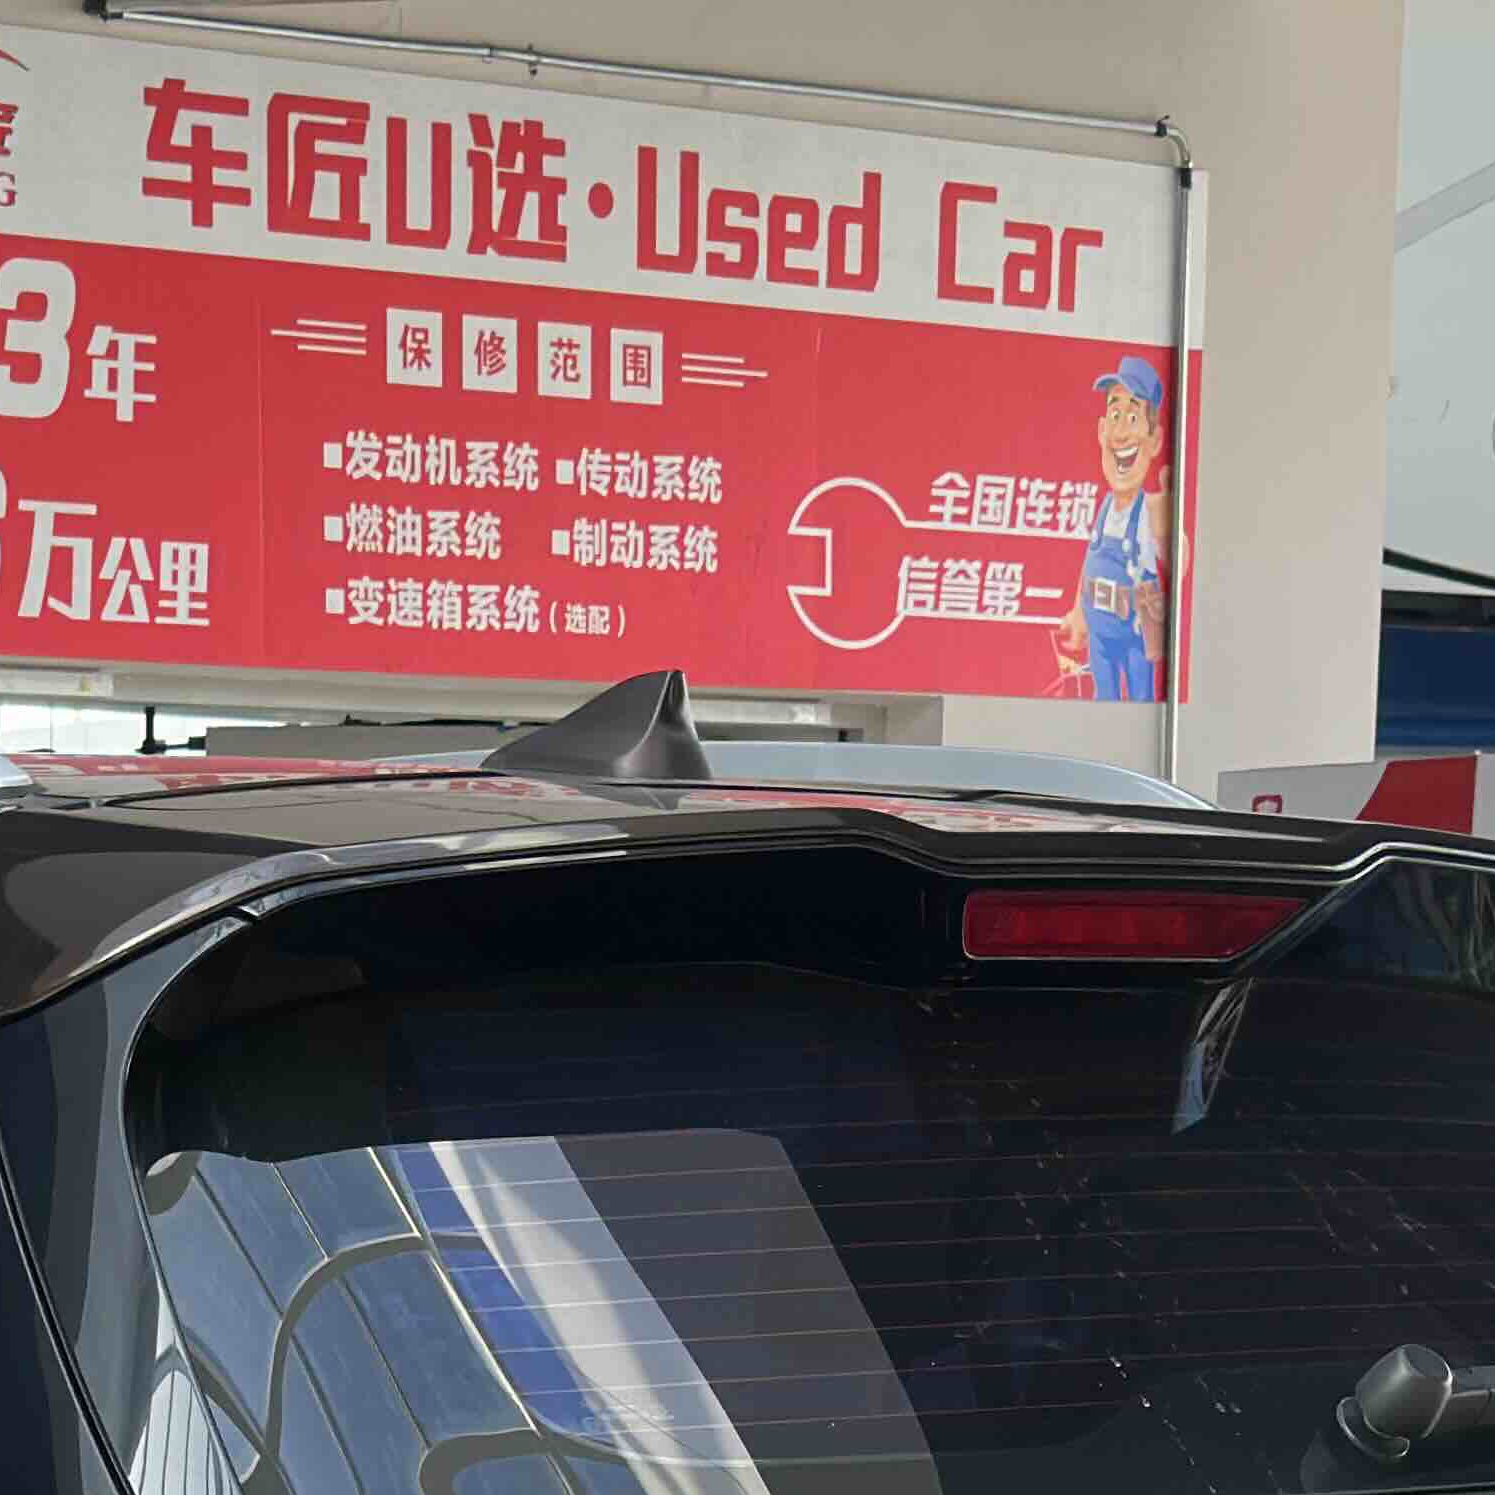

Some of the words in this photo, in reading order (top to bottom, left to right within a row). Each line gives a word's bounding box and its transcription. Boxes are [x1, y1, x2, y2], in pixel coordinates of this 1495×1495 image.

[937, 180, 1104, 314] Car
[398, 323, 652, 389] 保修范围
[344, 429, 540, 491] 发动机系统
[576, 448, 723, 504] 传动系统
[344, 502, 502, 560] 燃油系统
[572, 518, 719, 573] 制动系统
[928, 471, 1099, 537] 全国连锁
[897, 555, 1064, 616] 信誉第一
